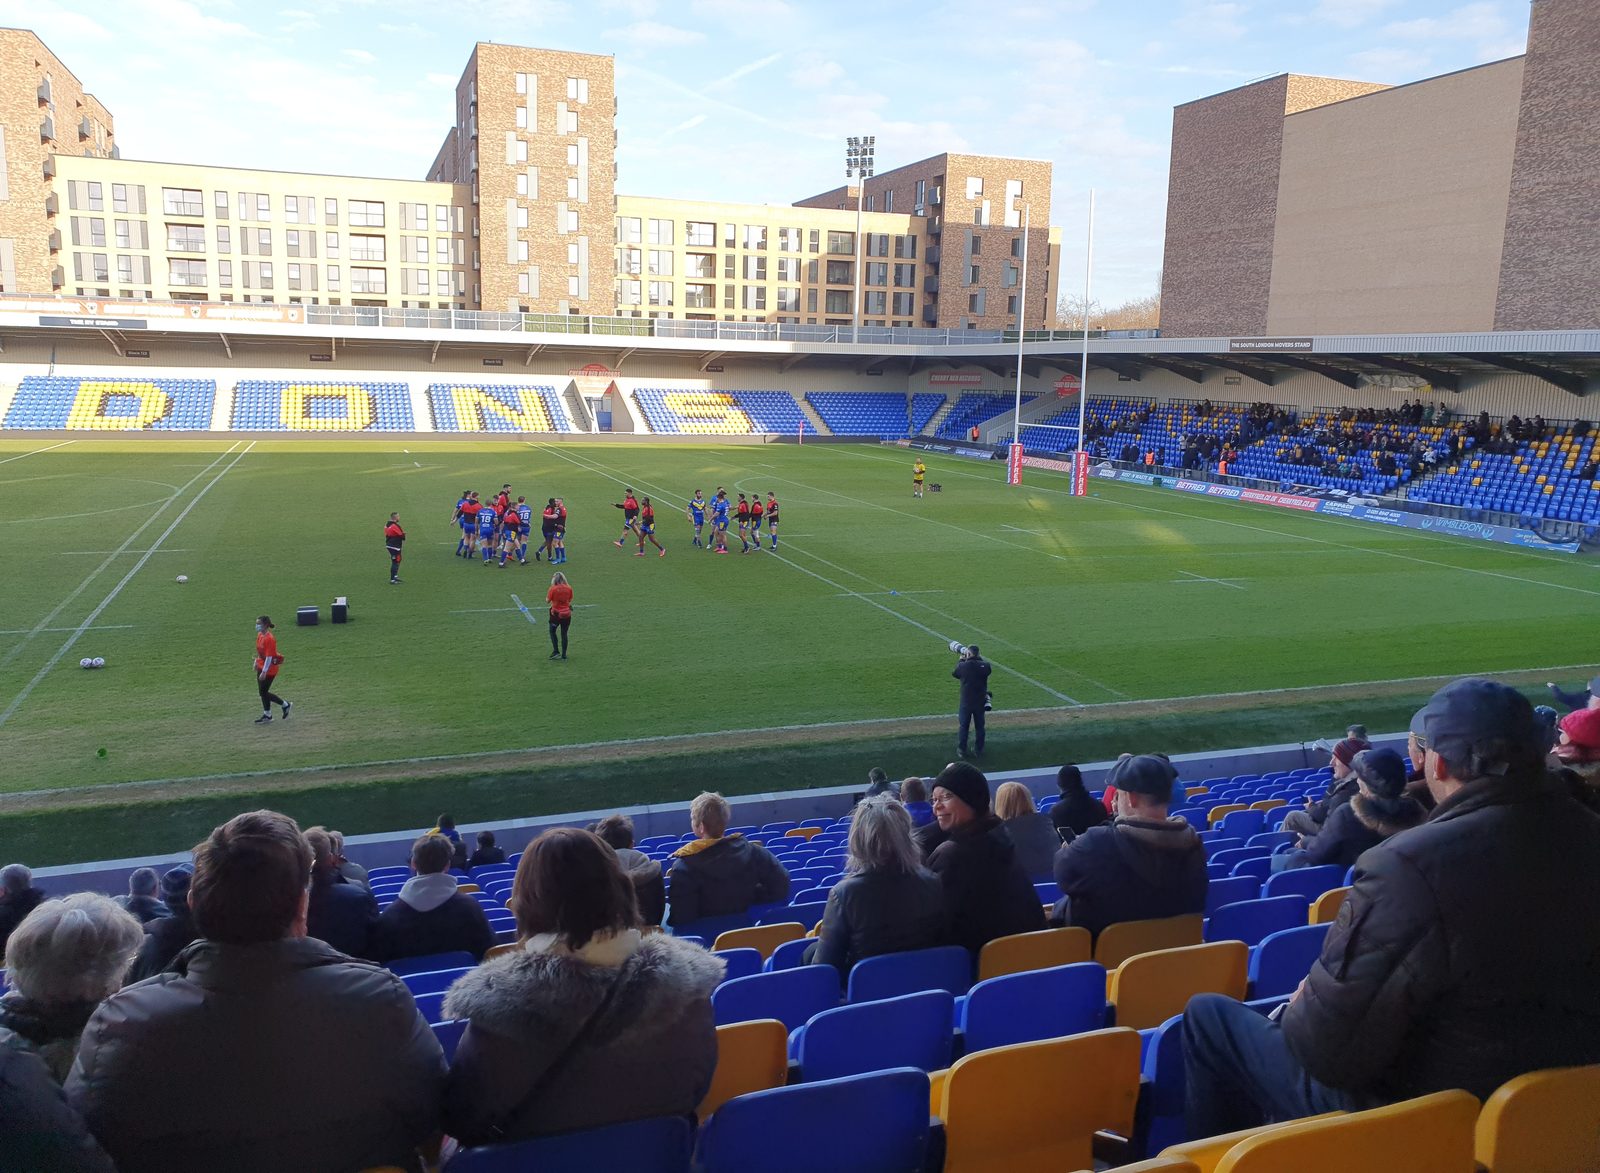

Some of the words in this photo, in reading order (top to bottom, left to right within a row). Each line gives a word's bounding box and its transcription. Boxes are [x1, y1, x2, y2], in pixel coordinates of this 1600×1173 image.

[1078, 453, 1086, 496] BETFRED
[1176, 481, 1206, 492] BETFRED
[1208, 486, 1240, 497] BETFRED
[1435, 518, 1483, 532] WIMBLEDON
